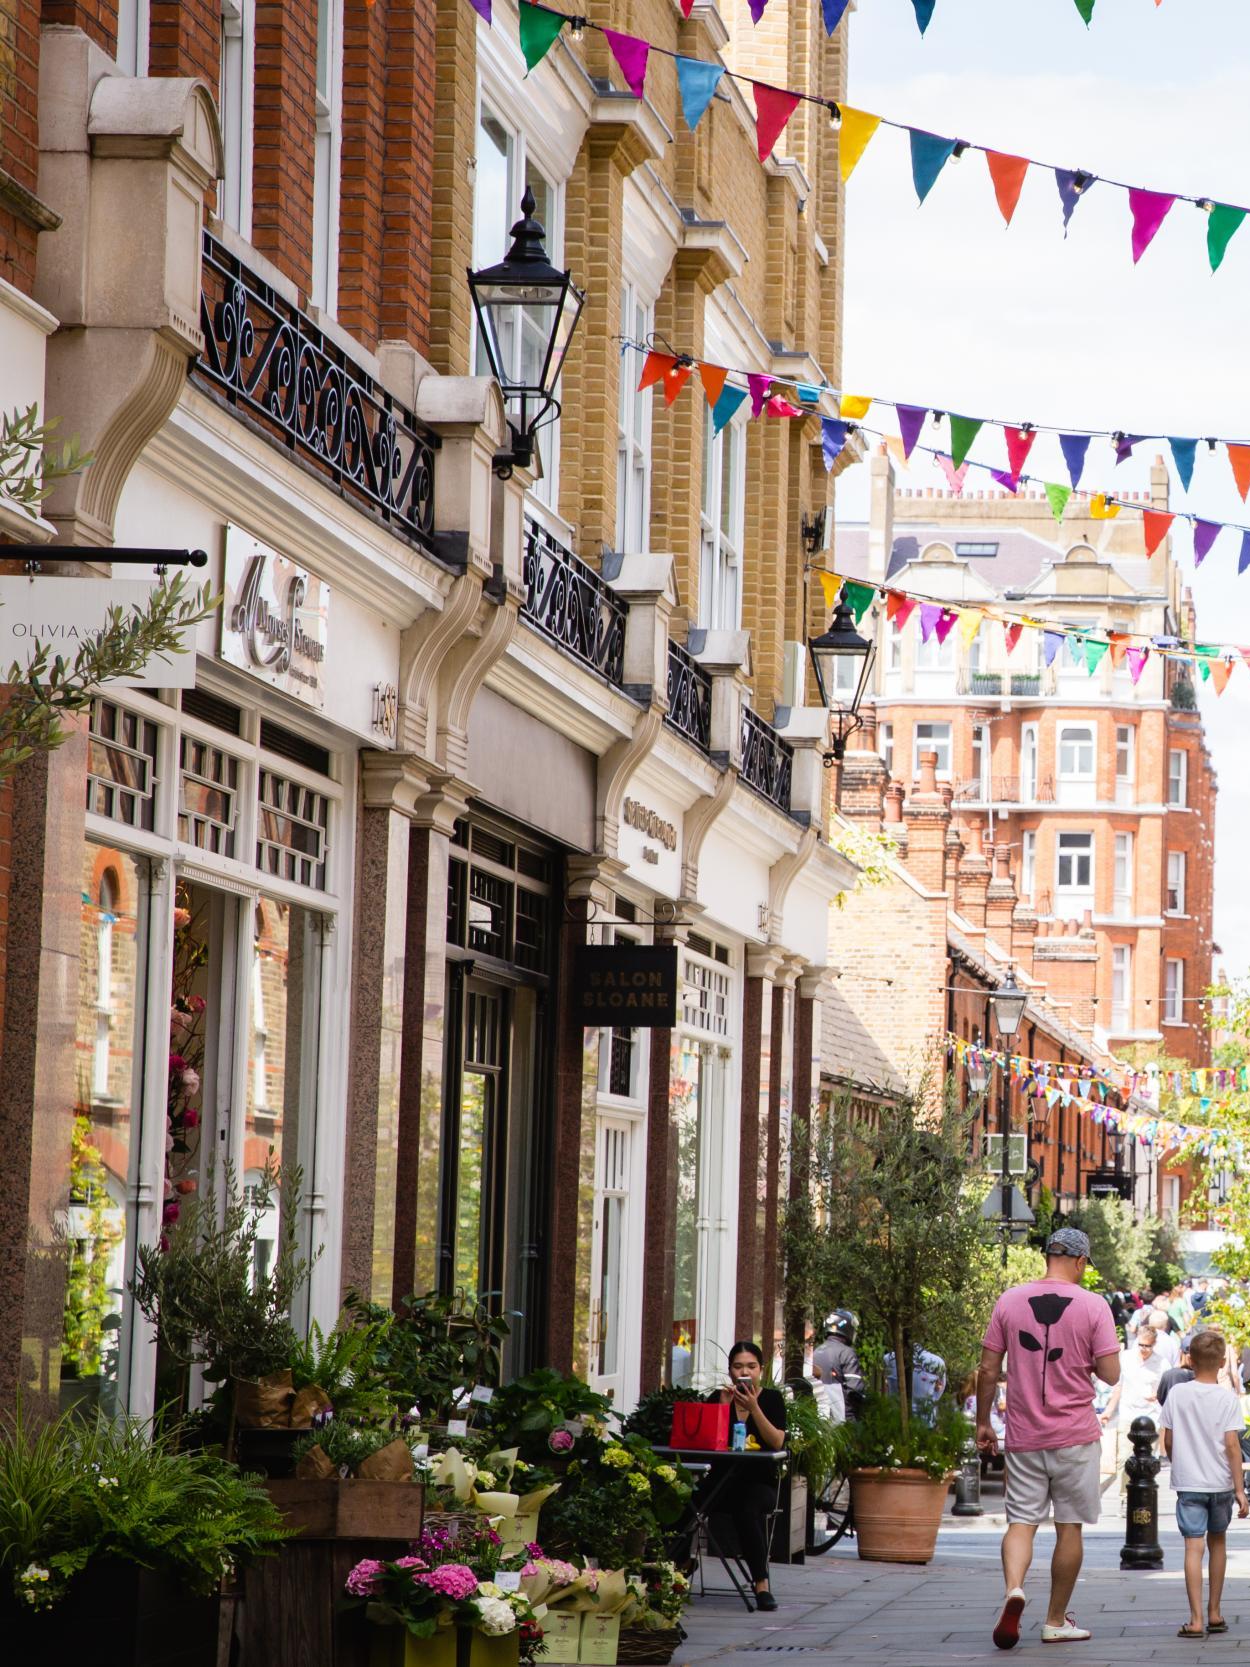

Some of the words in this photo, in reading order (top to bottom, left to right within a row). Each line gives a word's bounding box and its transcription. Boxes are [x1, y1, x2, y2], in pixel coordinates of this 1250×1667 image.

[12, 623, 79, 639] OLIVIA
[591, 971, 662, 987] SALON
[583, 992, 668, 1007] SLOANE
